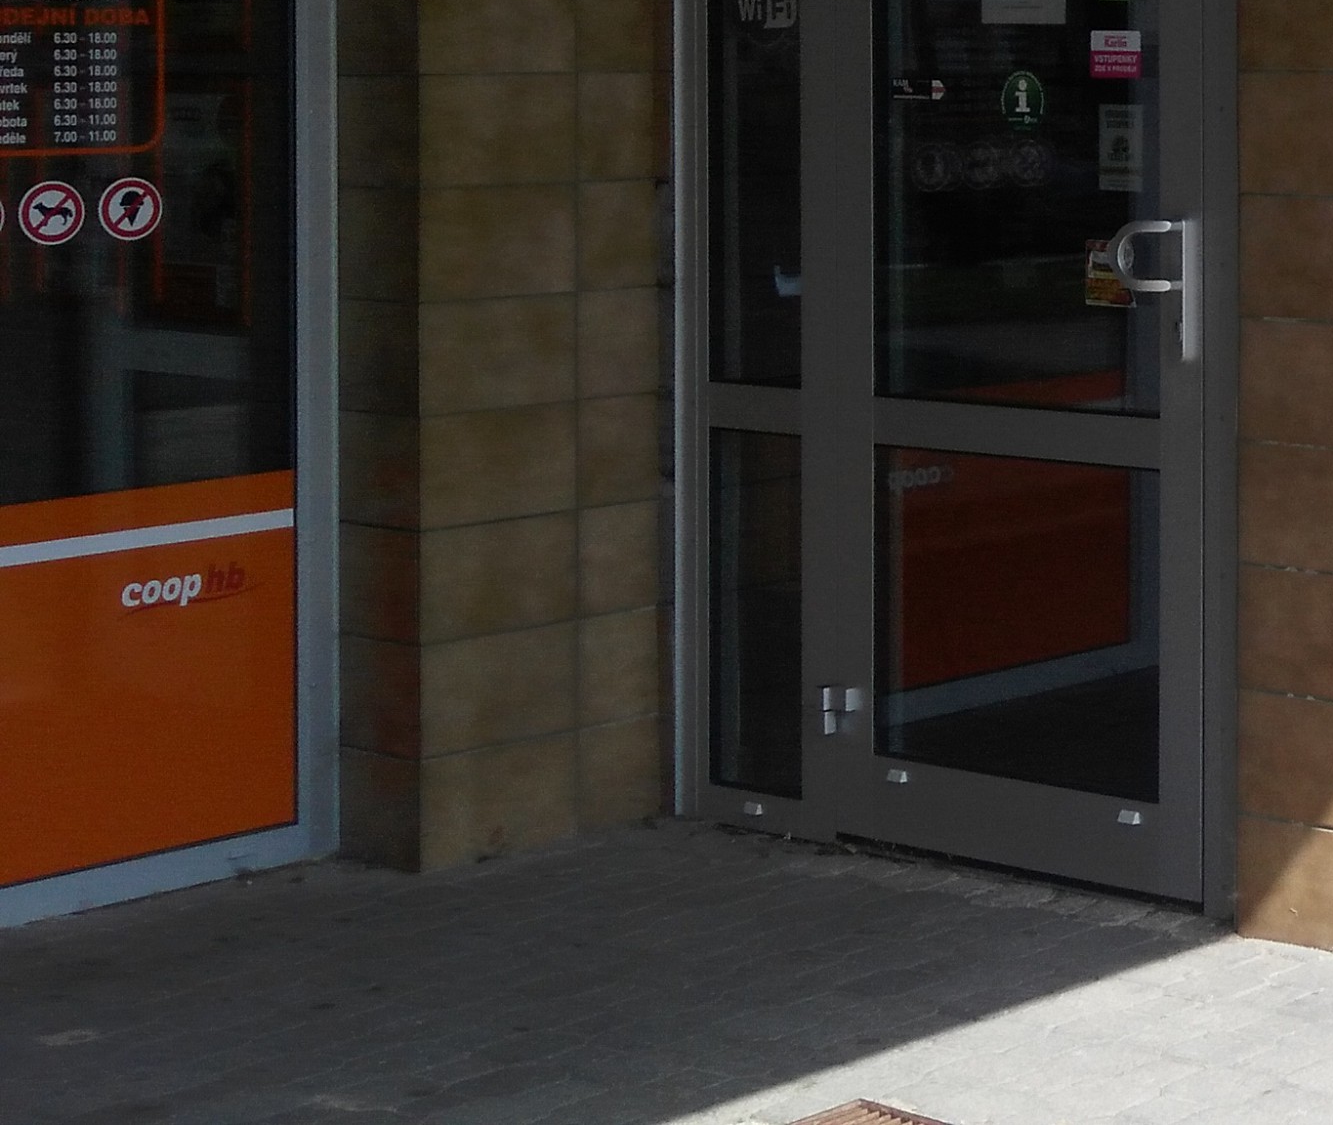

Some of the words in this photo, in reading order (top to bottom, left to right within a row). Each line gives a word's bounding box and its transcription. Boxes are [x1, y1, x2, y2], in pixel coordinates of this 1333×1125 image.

[83, 7, 150, 26] DOBA
[53, 32, 77, 45] 6.30
[89, 32, 118, 45] 18.00
[53, 49, 77, 61] 6.30
[89, 49, 118, 61] 18.00
[53, 65, 77, 77] 6.30
[89, 65, 118, 77] 18.00
[53, 82, 77, 94] 6.30
[89, 82, 118, 94] 18.00
[53, 98, 77, 111] 6.30
[89, 97, 118, 110] 18.00
[53, 114, 77, 127] 6.30
[89, 113, 118, 126] 11.00
[53, 131, 77, 143] 7.00
[89, 130, 118, 142] 11.00
[121, 573, 203, 607] coop
